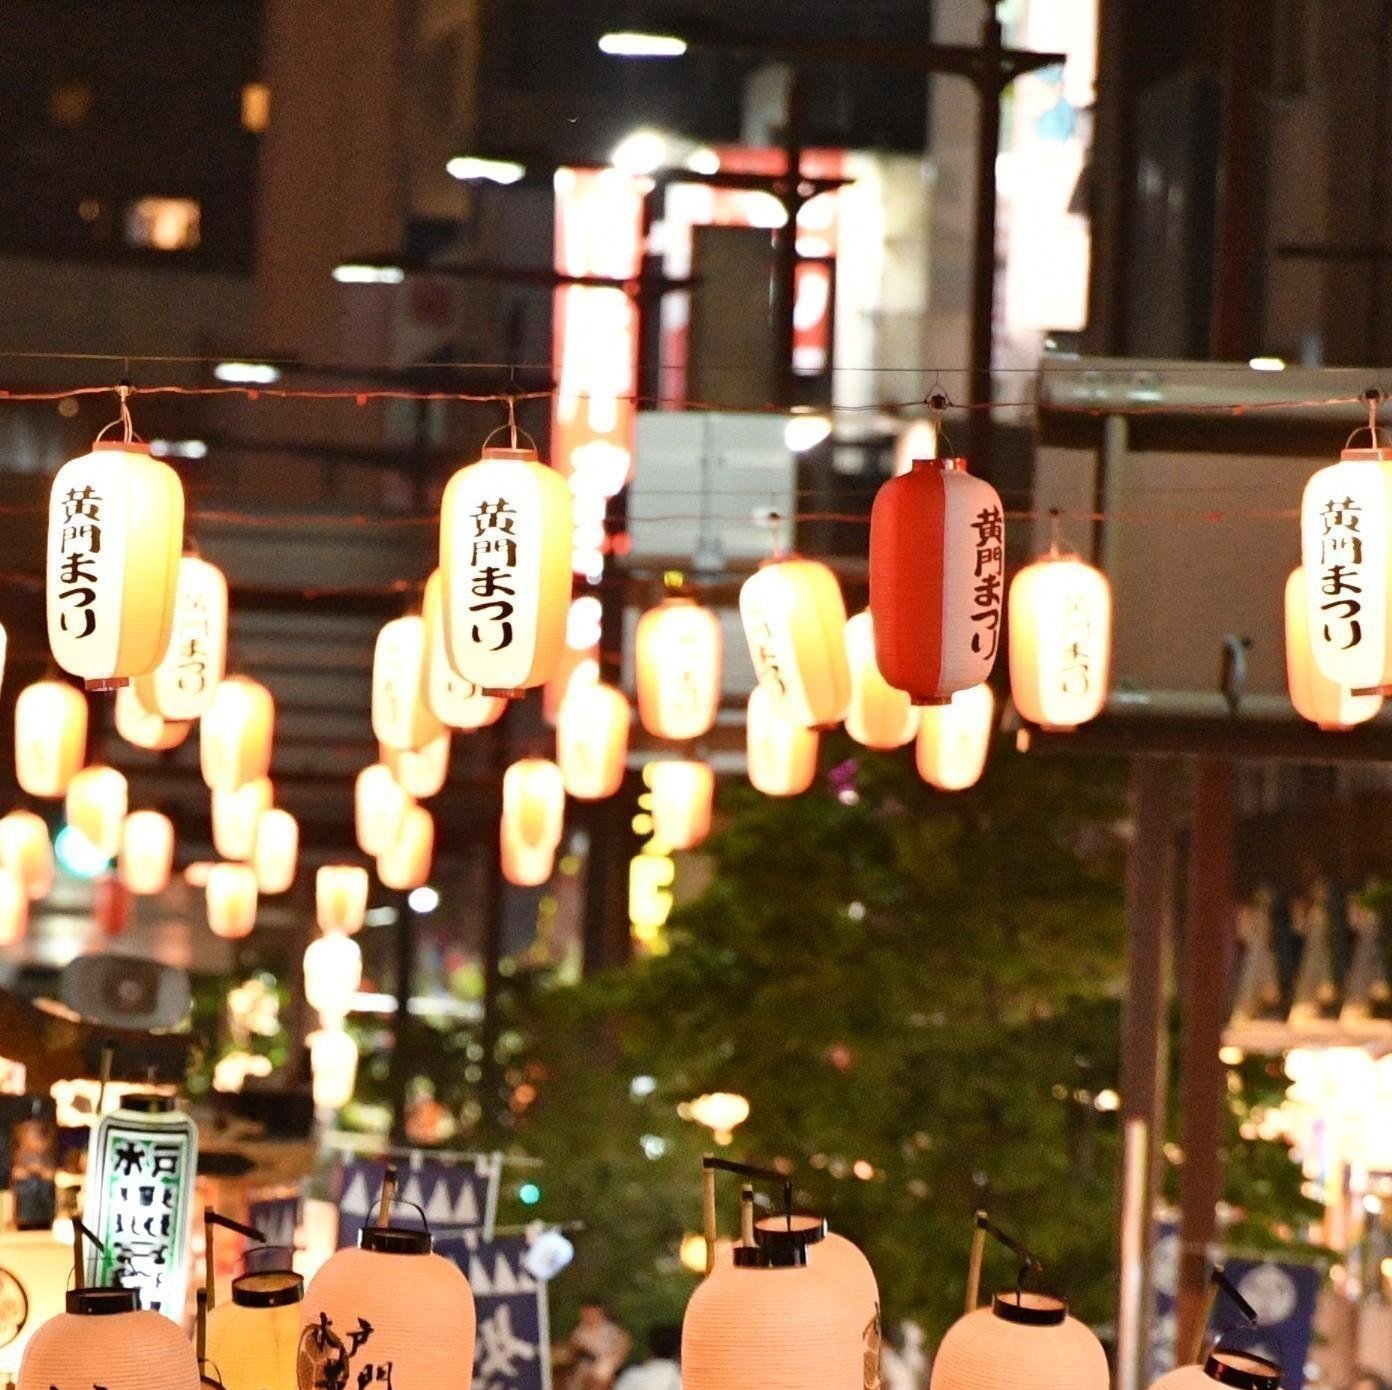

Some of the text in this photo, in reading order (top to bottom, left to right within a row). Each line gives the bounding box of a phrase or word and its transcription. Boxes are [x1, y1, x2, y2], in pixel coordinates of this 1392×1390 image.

[57, 486, 103, 640] 黄門まつり
[469, 498, 517, 651] 黄門まつり
[970, 505, 1003, 660] 黄門まつり
[1320, 496, 1364, 650] 黄門まつり
